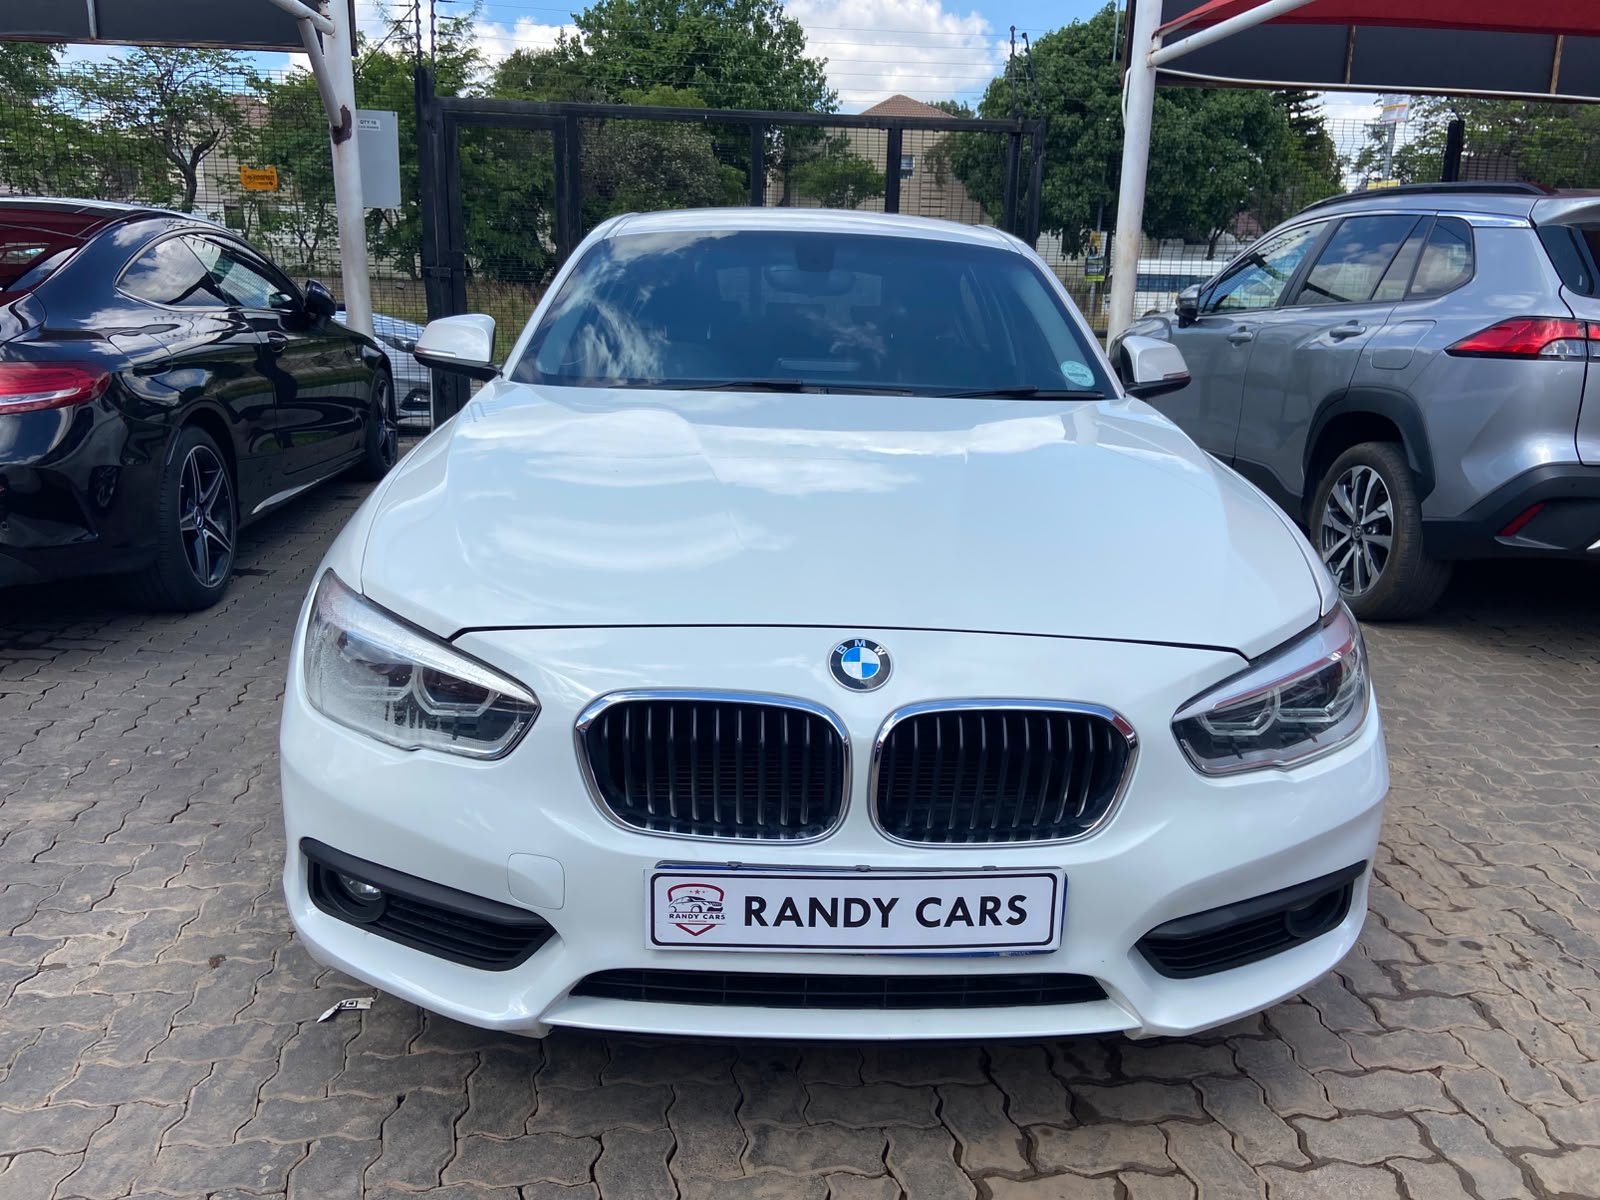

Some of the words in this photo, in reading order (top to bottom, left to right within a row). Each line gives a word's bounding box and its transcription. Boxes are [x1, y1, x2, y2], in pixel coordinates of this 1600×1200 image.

[835, 639, 887, 656] BMW
[744, 895, 899, 928] RANDY
[915, 894, 1028, 928] CARS
